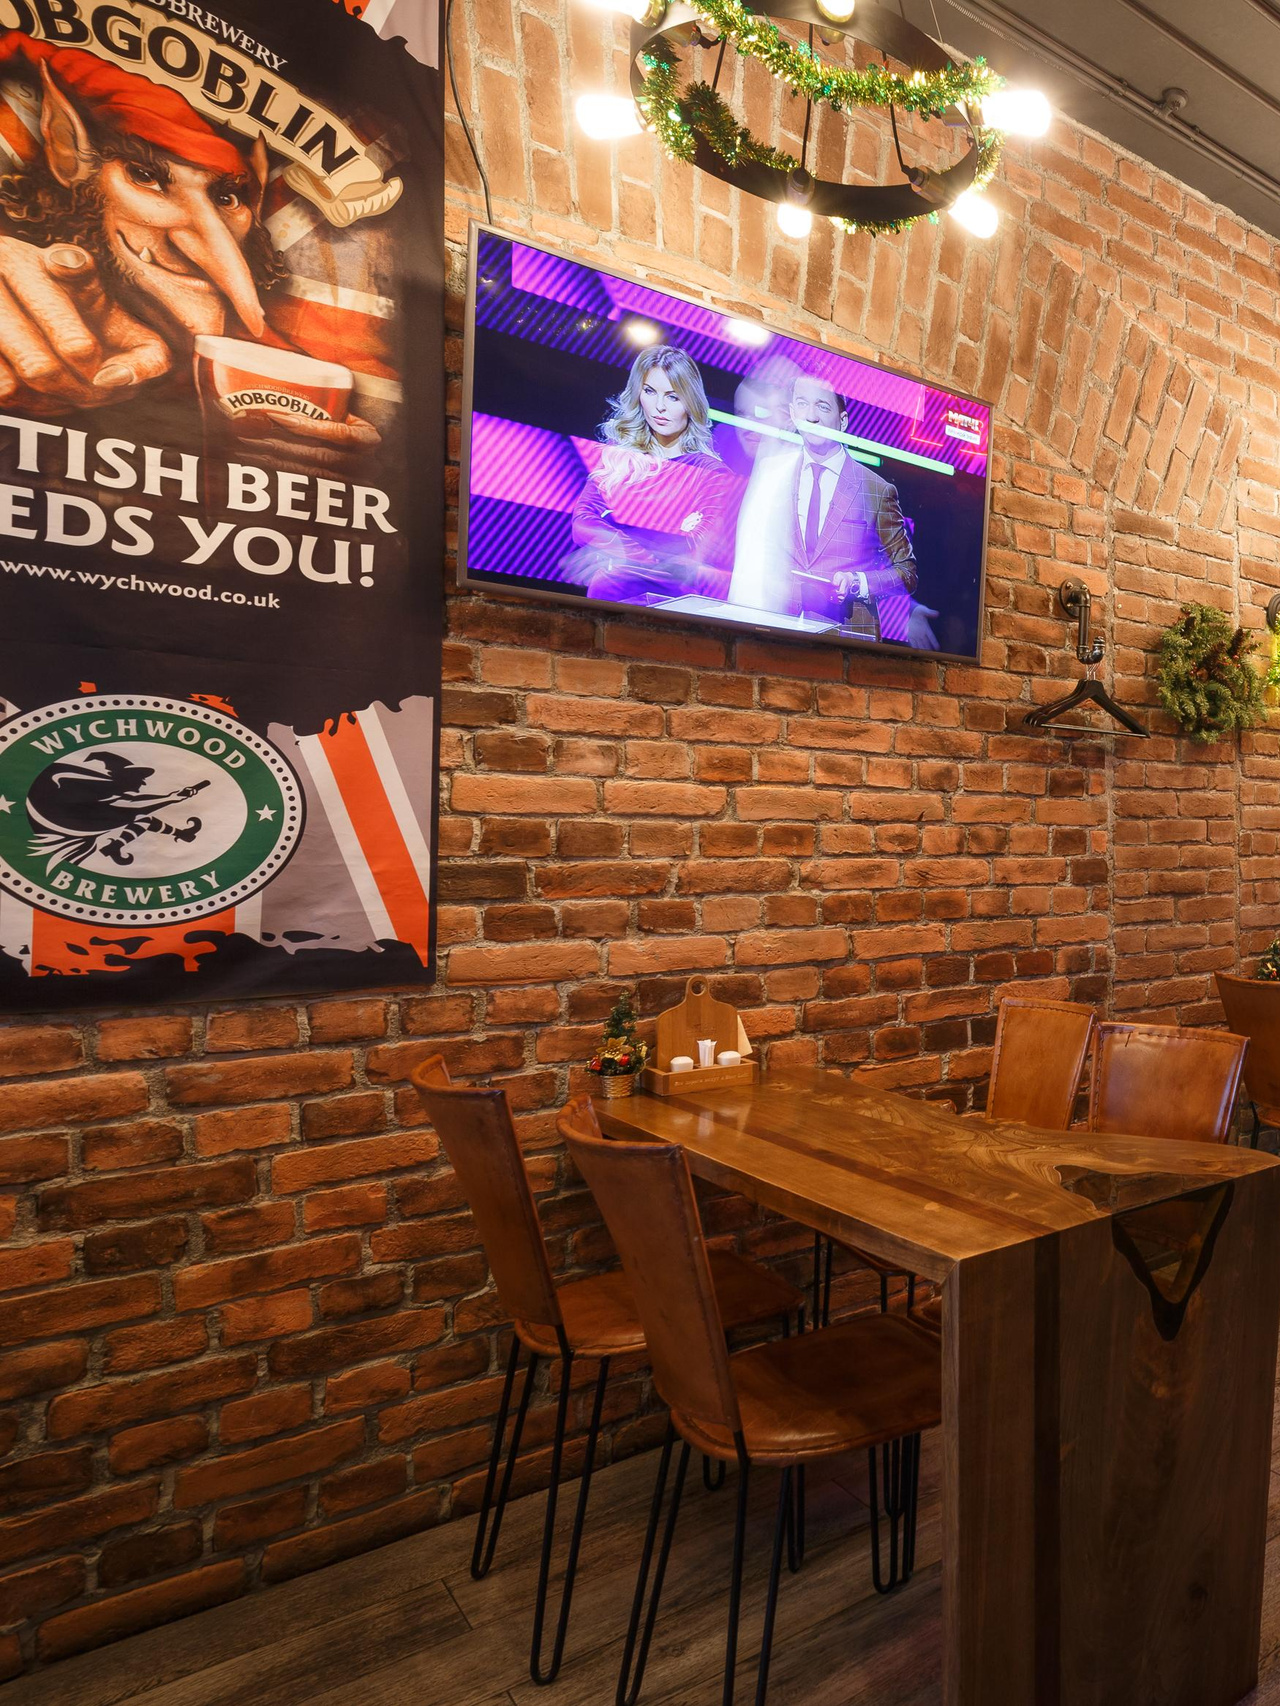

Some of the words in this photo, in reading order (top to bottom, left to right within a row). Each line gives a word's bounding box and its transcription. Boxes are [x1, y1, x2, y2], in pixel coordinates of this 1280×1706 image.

[226, 462, 398, 534] BEER
[0, 560, 281, 609] www.wychwood.co.uk
[30, 718, 247, 769] WYCHWOOD
[50, 870, 220, 905] BREWERY
